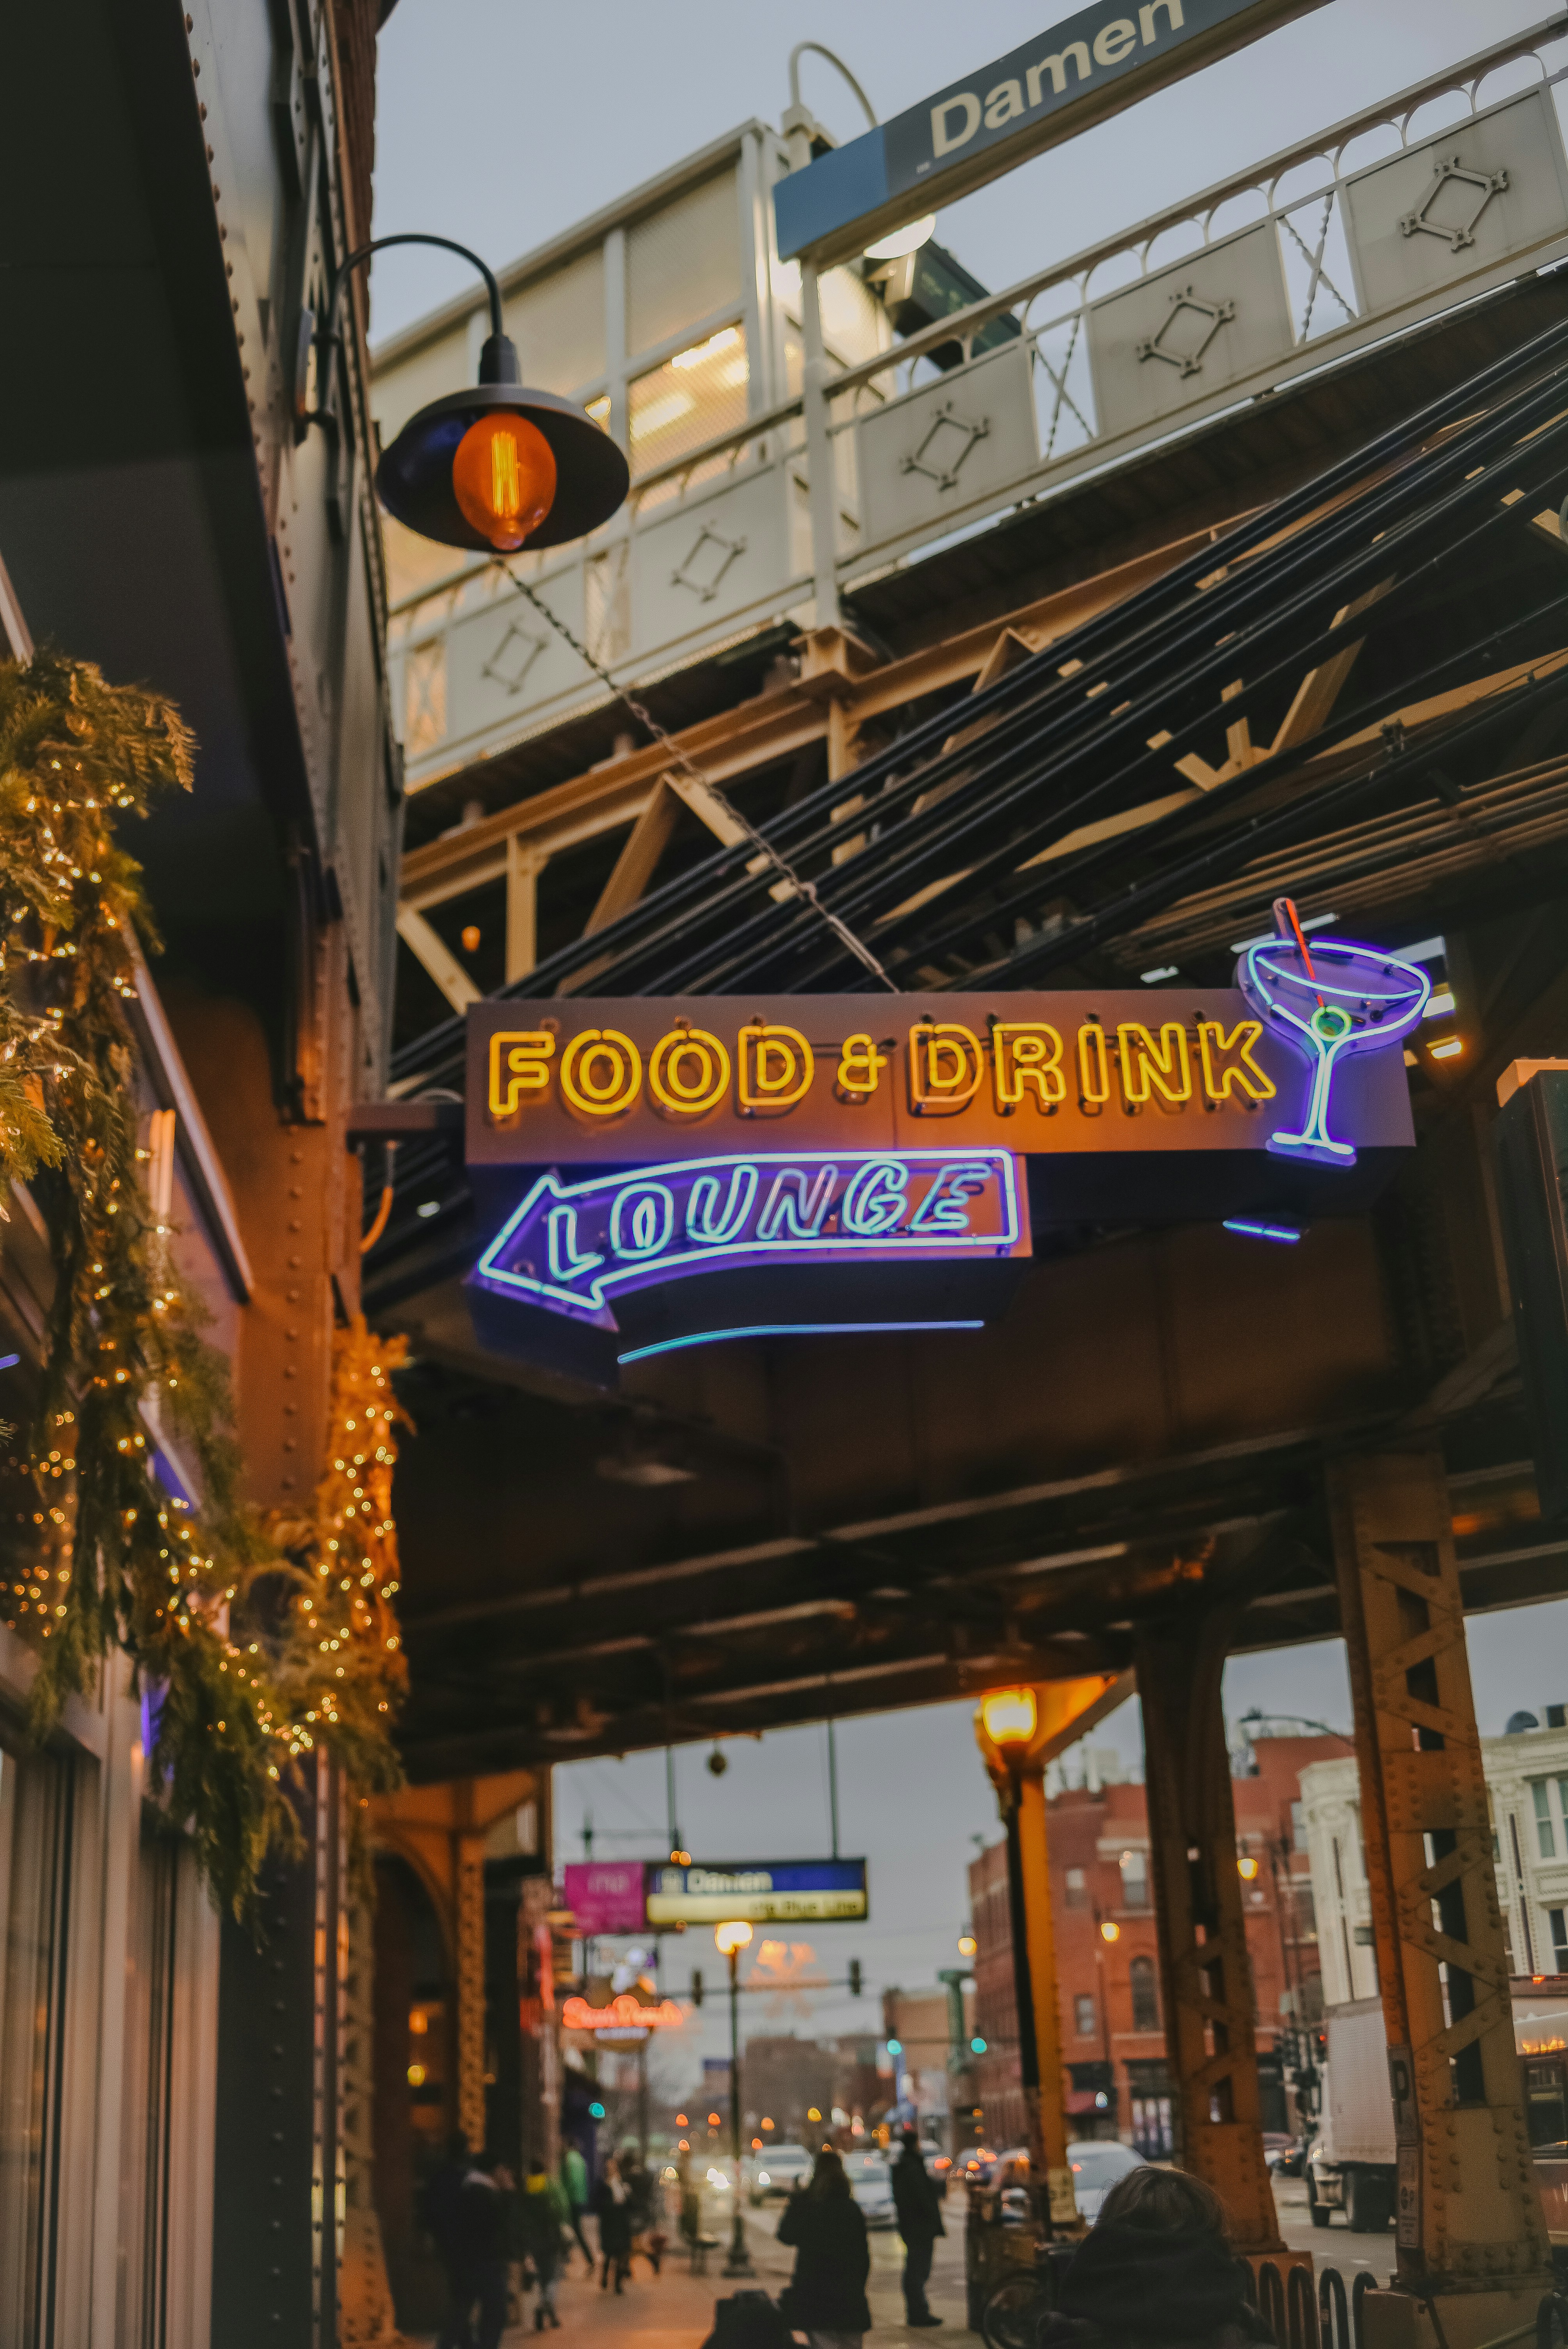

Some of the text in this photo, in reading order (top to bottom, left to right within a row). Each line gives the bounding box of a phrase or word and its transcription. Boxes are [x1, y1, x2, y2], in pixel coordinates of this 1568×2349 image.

[931, 0, 1186, 157] Damen
[489, 1020, 1276, 1115] FOOD & DRINK
[548, 1159, 993, 1281] LOUNGE
